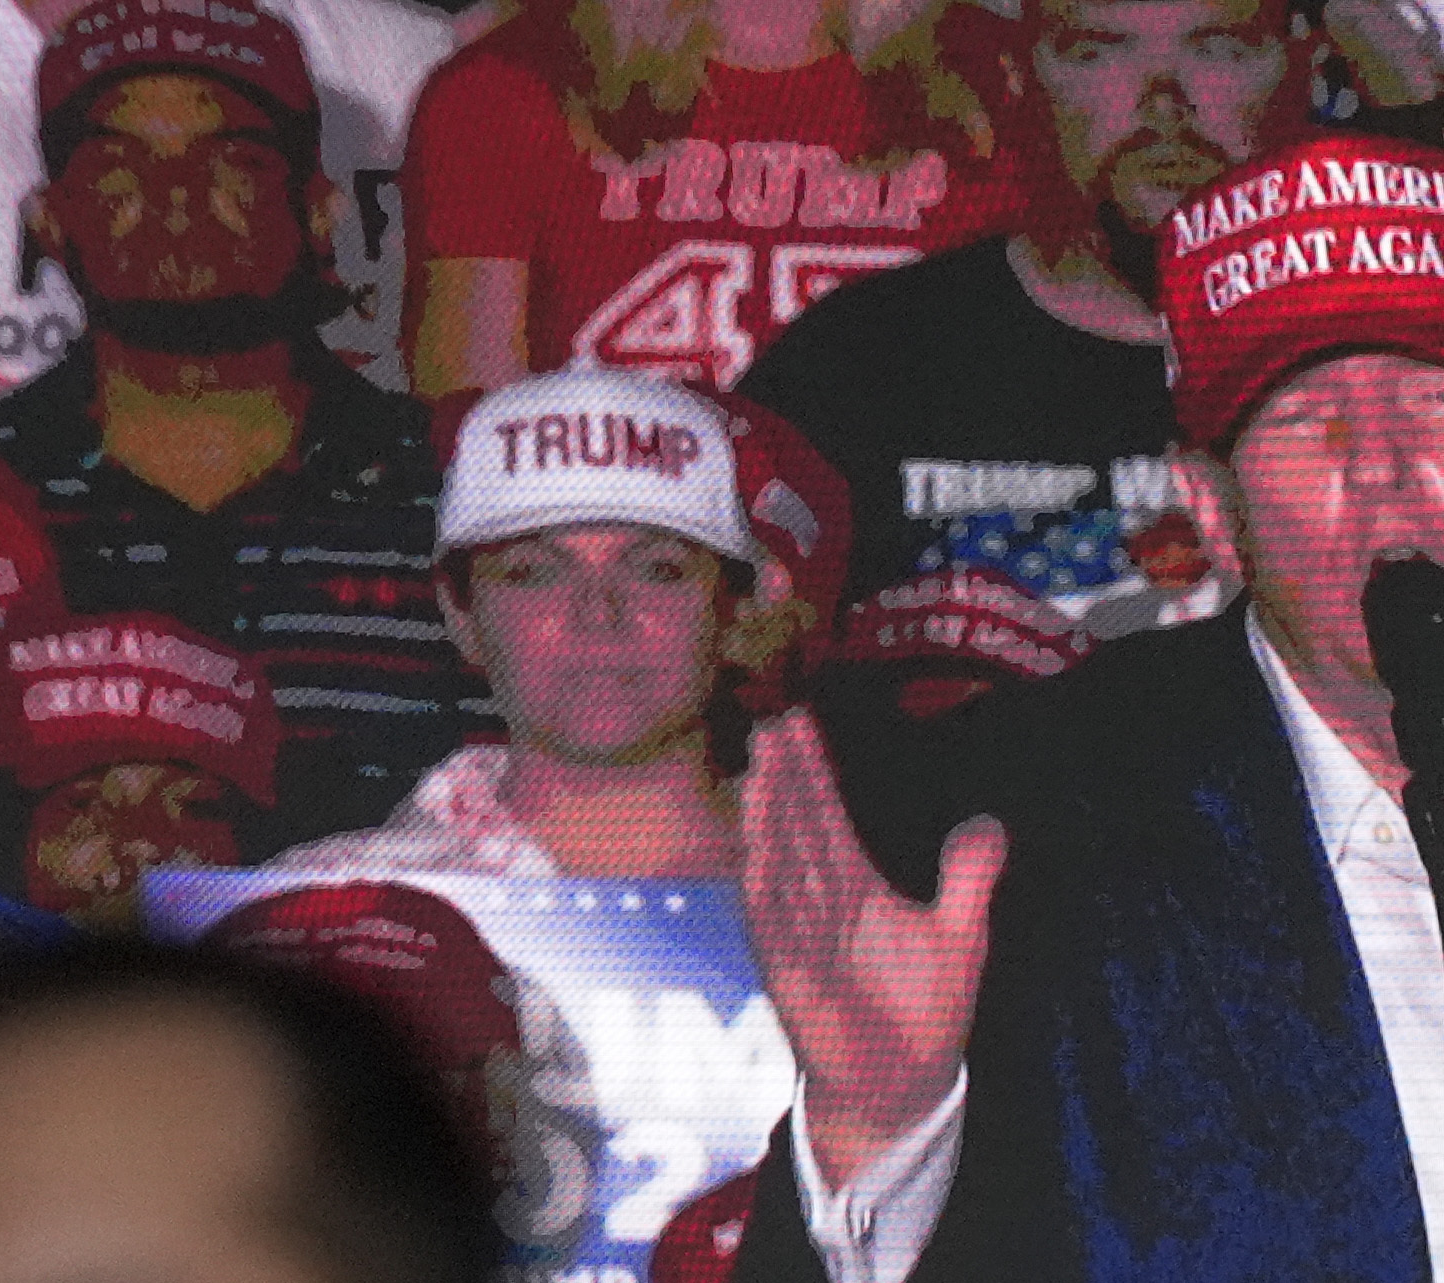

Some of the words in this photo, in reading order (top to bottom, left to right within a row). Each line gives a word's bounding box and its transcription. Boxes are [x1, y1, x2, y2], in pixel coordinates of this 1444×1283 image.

[1172, 171, 1290, 258] MAKE
[1203, 227, 1339, 315] GREAT
[494, 409, 701, 479] TRUMP
